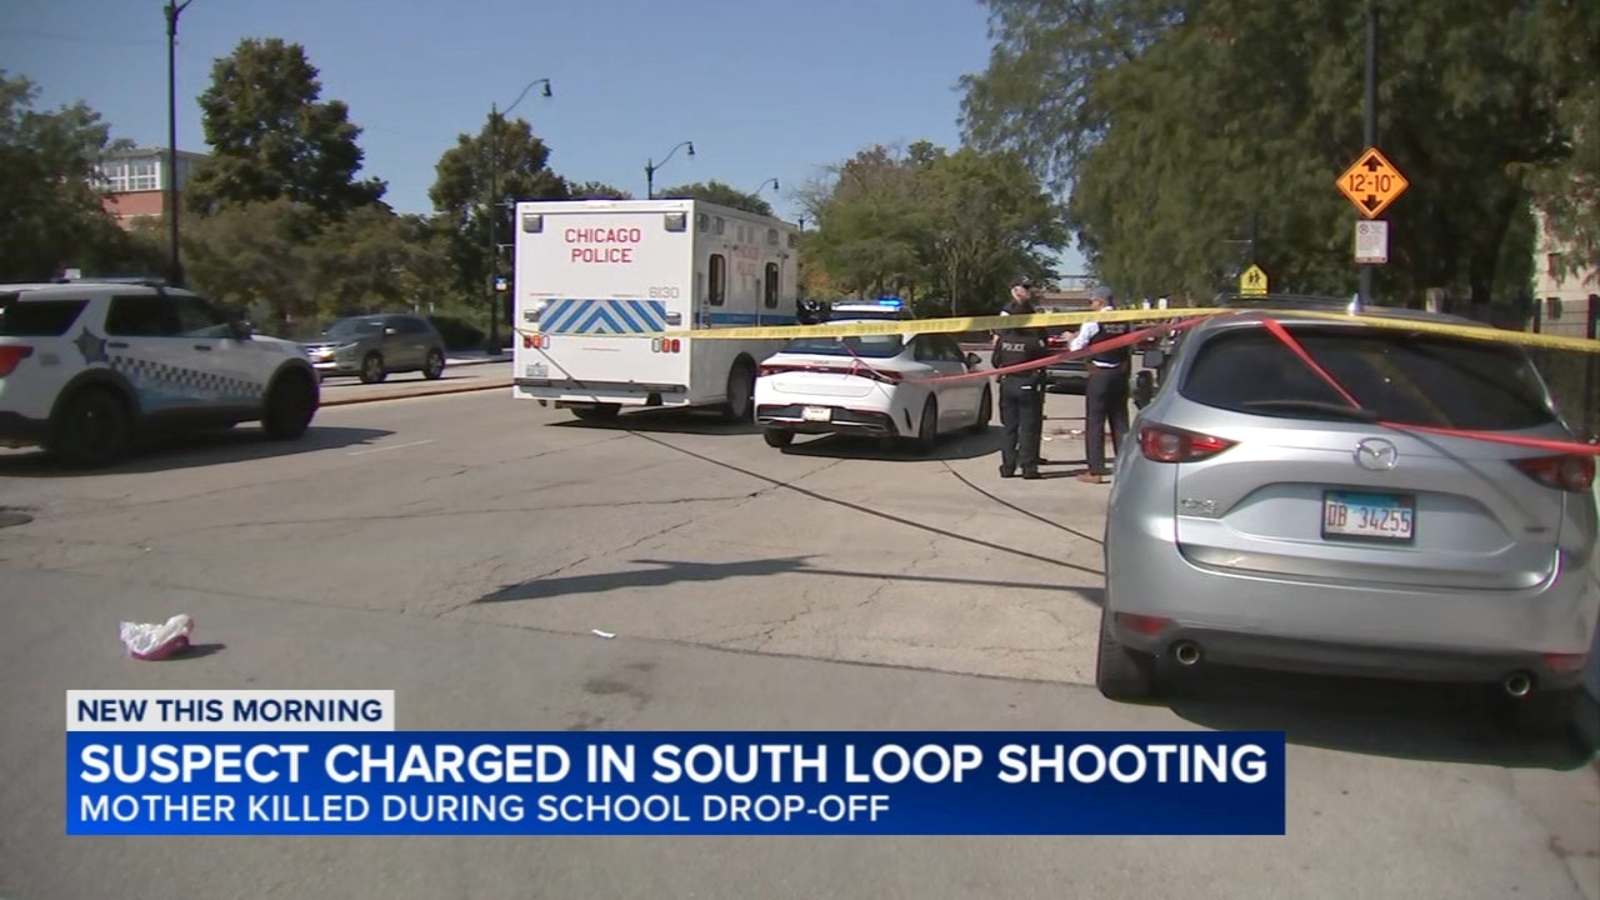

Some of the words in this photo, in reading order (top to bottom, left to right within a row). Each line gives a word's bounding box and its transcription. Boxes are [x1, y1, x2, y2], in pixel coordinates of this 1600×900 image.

[564, 228, 641, 243] CHICAGO
[571, 248, 633, 263] POLICE
[649, 286, 680, 299] 6130
[1001, 342, 1025, 352] POLICE
[1358, 506, 1410, 533] 34255
